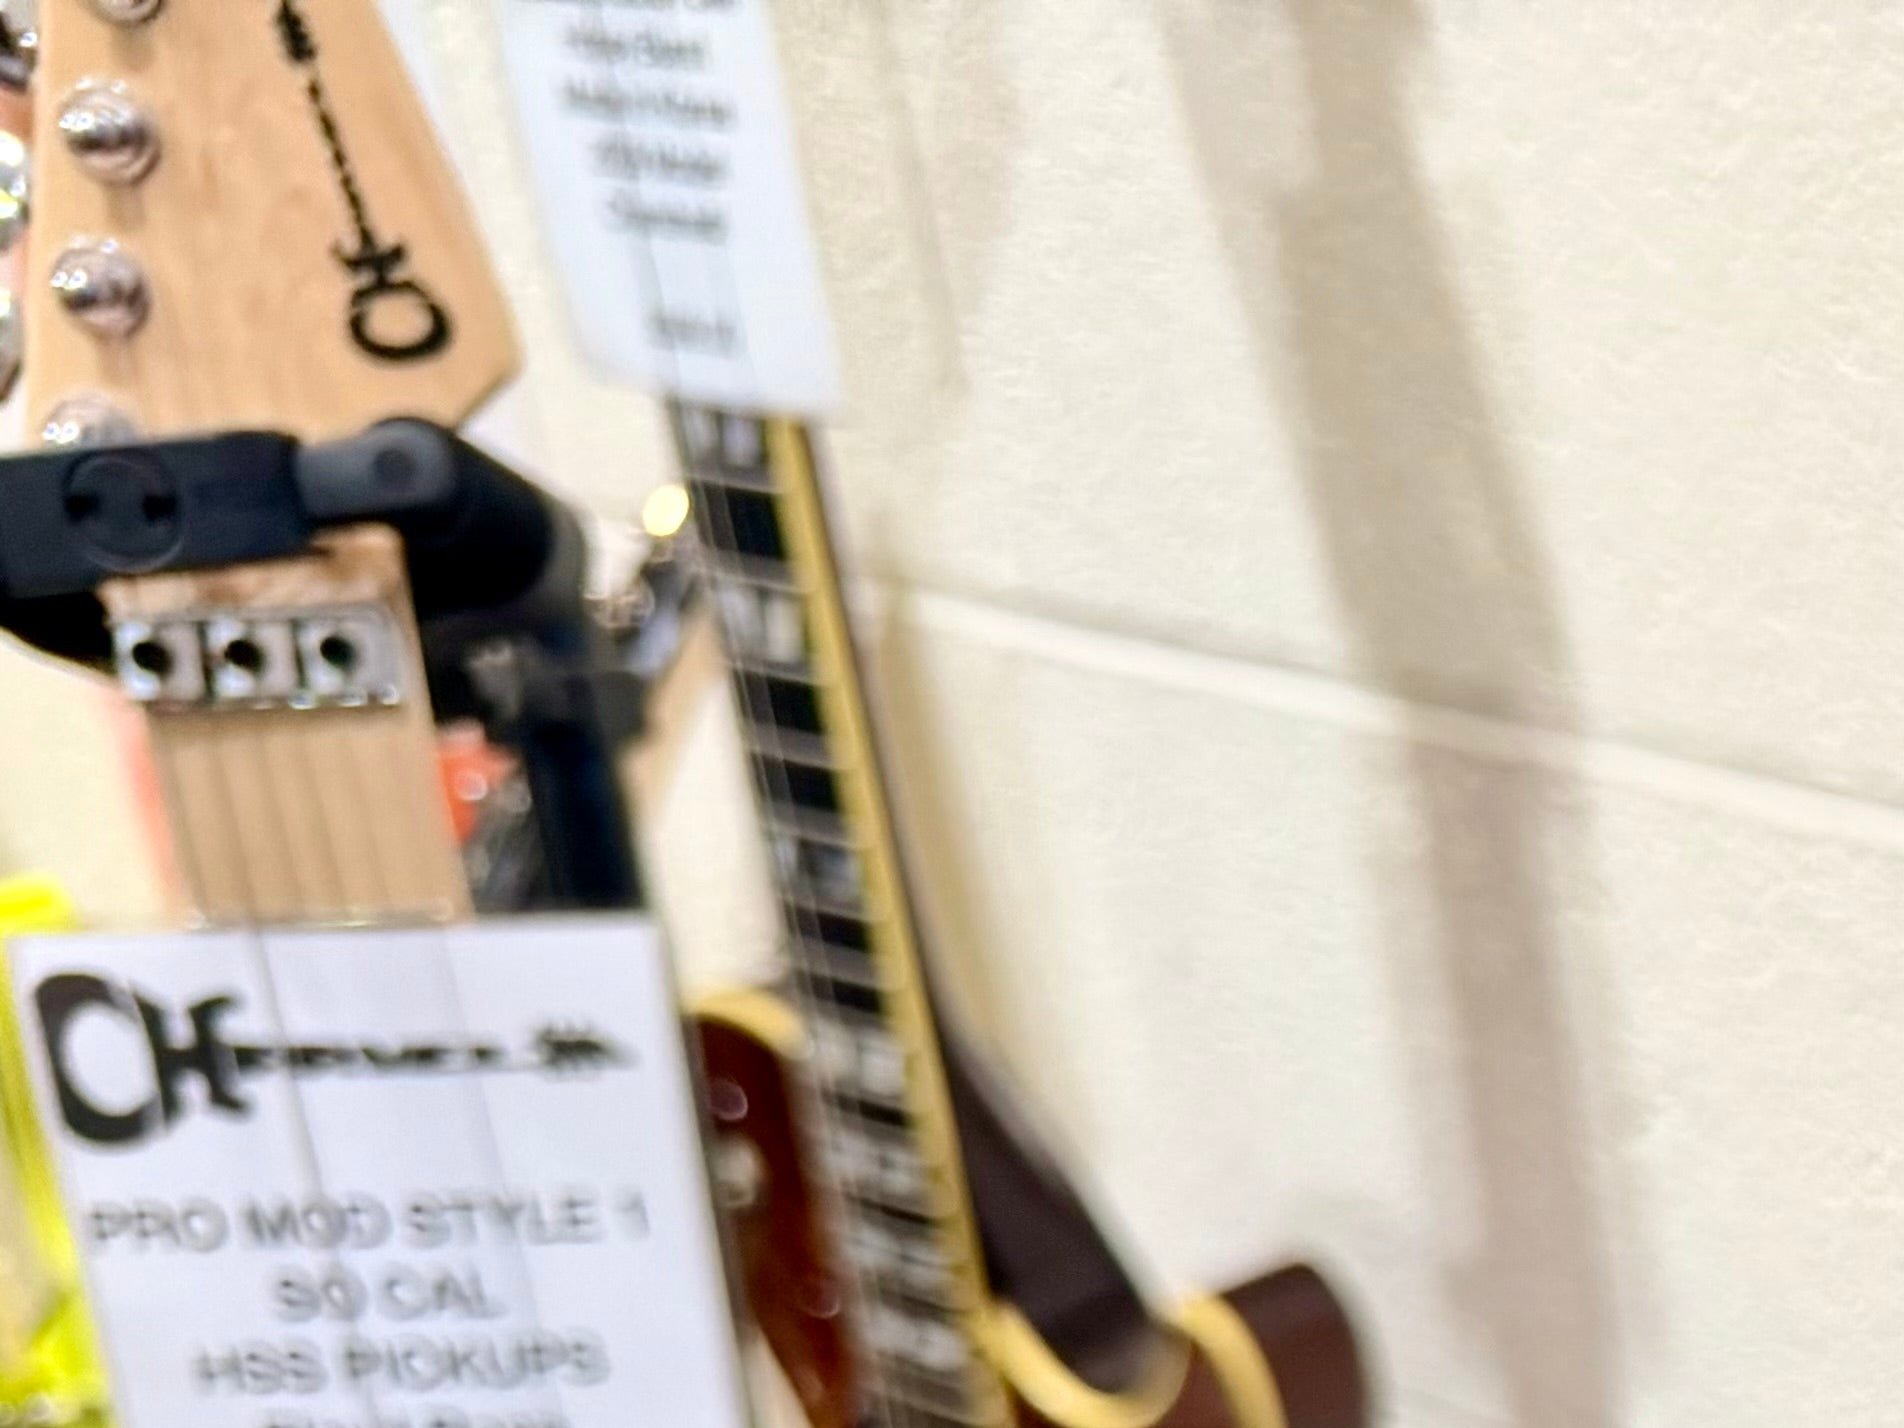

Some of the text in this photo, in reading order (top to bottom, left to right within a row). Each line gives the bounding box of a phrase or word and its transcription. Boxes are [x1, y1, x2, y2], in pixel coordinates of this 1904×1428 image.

[89, 1199, 229, 1255] PRO
[243, 1193, 393, 1252] MOD
[406, 1187, 604, 1250] STYLE
[273, 1258, 505, 1324] SO CAL
[192, 1324, 612, 1397] HSS PICKUPS
